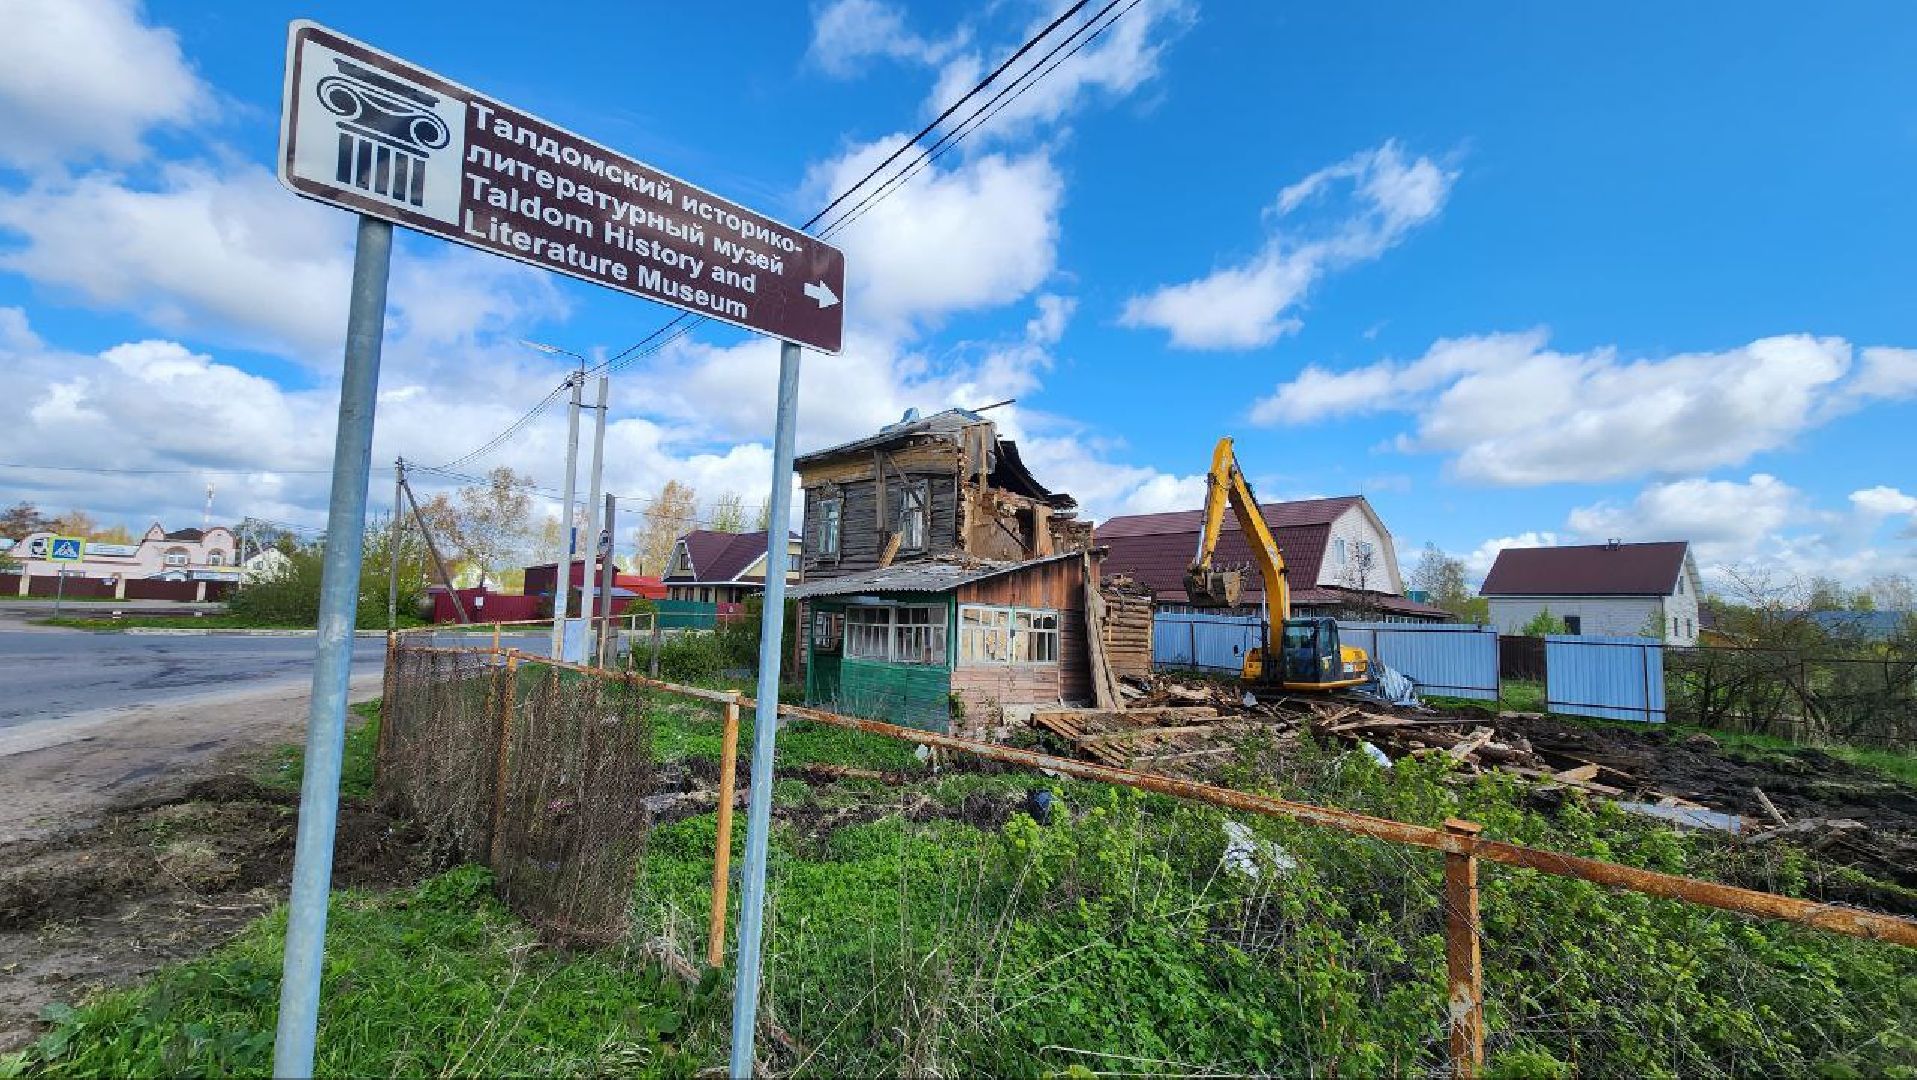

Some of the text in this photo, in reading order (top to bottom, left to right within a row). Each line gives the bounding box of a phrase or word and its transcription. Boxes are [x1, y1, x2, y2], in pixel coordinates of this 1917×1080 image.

[466, 173, 756, 293] Taldom History and
[467, 144, 783, 275] литературный музей
[470, 101, 802, 253] Талдомский историко-
[465, 208, 747, 318] Literature Museum
